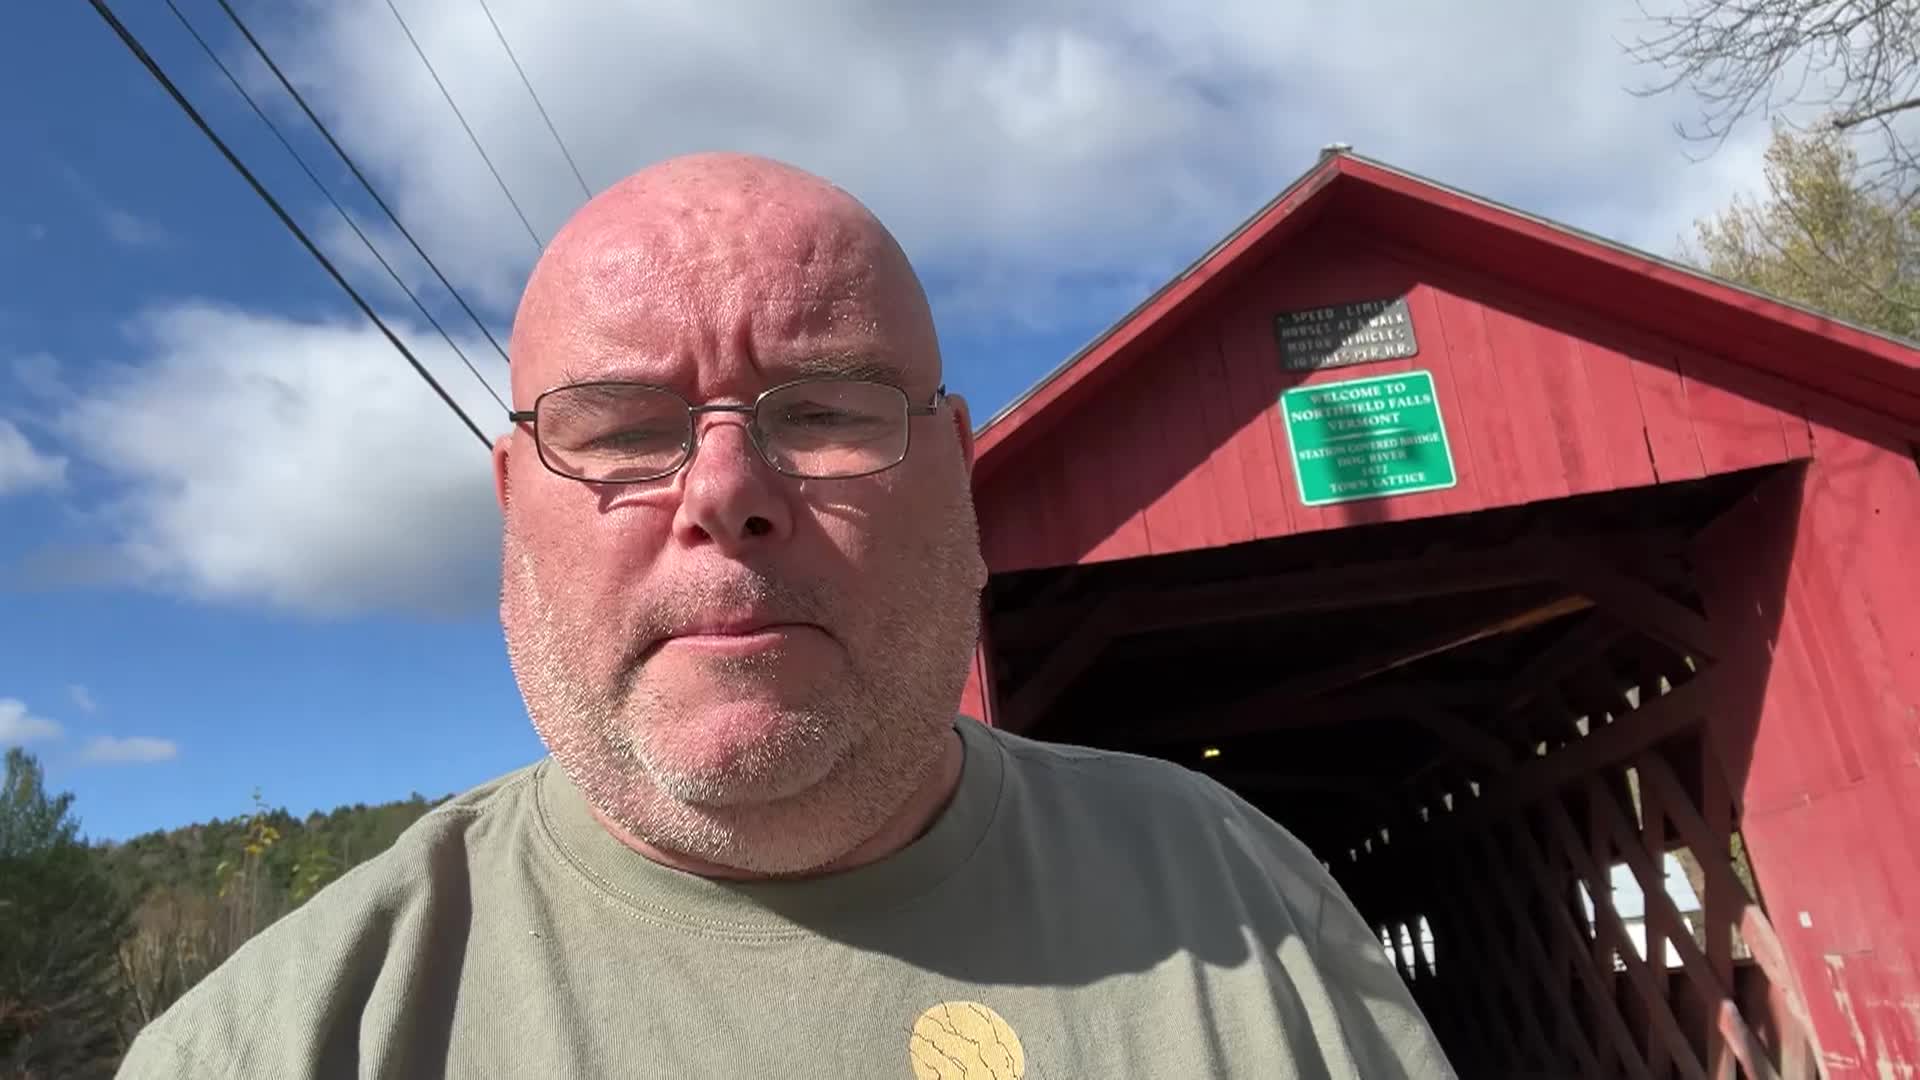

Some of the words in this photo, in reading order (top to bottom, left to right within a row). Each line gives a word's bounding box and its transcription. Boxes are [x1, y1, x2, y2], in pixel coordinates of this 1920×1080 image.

[1292, 307, 1334, 322] SPEED
[1345, 300, 1388, 317] LIMIT
[1369, 312, 1404, 328] WALK
[1287, 336, 1333, 352] MOTOR
[1340, 328, 1404, 346] VEHICLES
[1354, 346, 1379, 361] PER
[1311, 385, 1381, 403] WELCOME
[1385, 382, 1406, 395] TO
[1291, 401, 1385, 423] NORTHFIELD
[1389, 394, 1431, 409] FALLS
[1327, 412, 1400, 430] VERMONT
[1299, 446, 1346, 460] STATION
[1348, 438, 1398, 453] COVERED
[1400, 433, 1440, 447] BRIDGE
[1337, 454, 1366, 467] DOG
[1369, 450, 1408, 463] RIVER
[1329, 479, 1368, 493] TOWN
[1373, 472, 1426, 488] LATTICE
